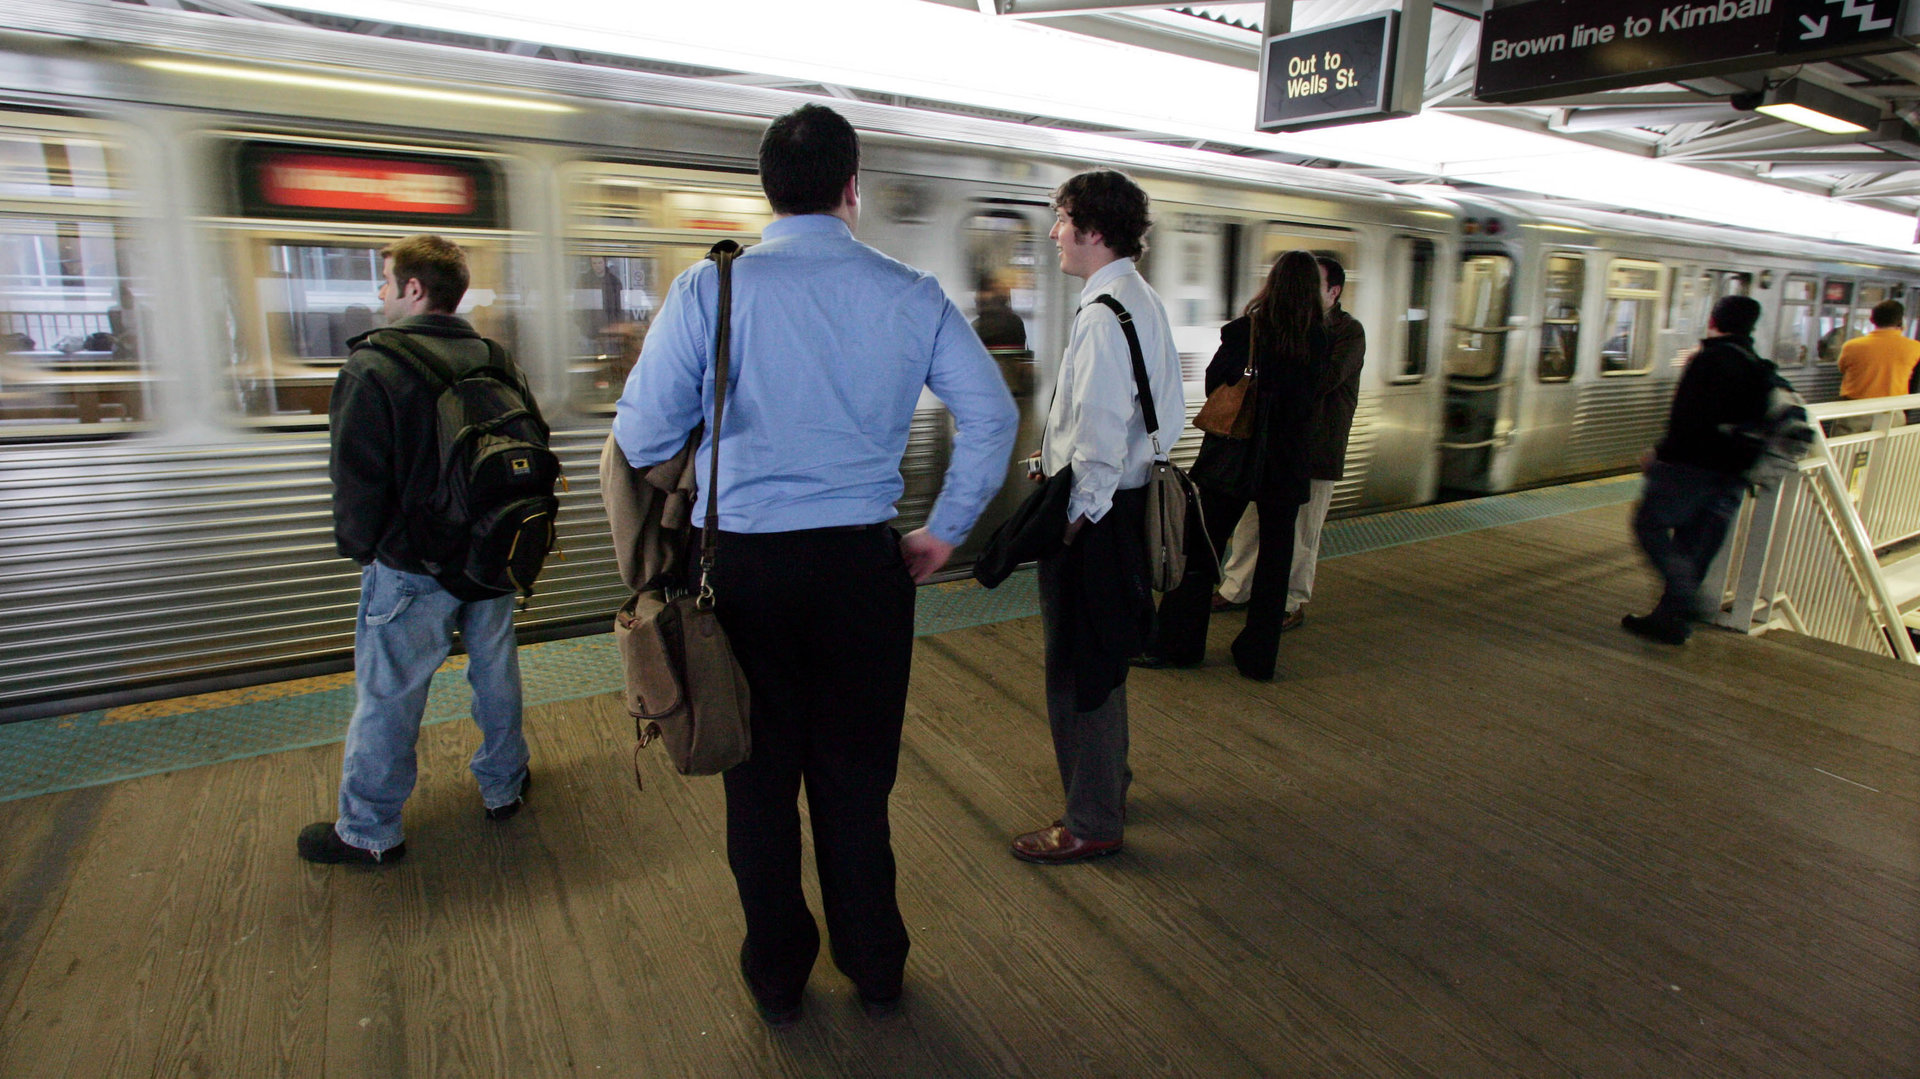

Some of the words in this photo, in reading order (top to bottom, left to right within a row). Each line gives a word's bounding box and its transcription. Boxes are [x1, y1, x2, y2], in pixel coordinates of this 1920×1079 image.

[1490, 33, 1565, 62] Brown
[1571, 24, 1615, 48] line
[1624, 16, 1652, 38] to
[1659, 0, 1773, 33] Kimball
[1288, 54, 1317, 77] Out
[1324, 51, 1341, 71] to
[1287, 74, 1328, 98] Wells
[1335, 68, 1358, 90] St.
